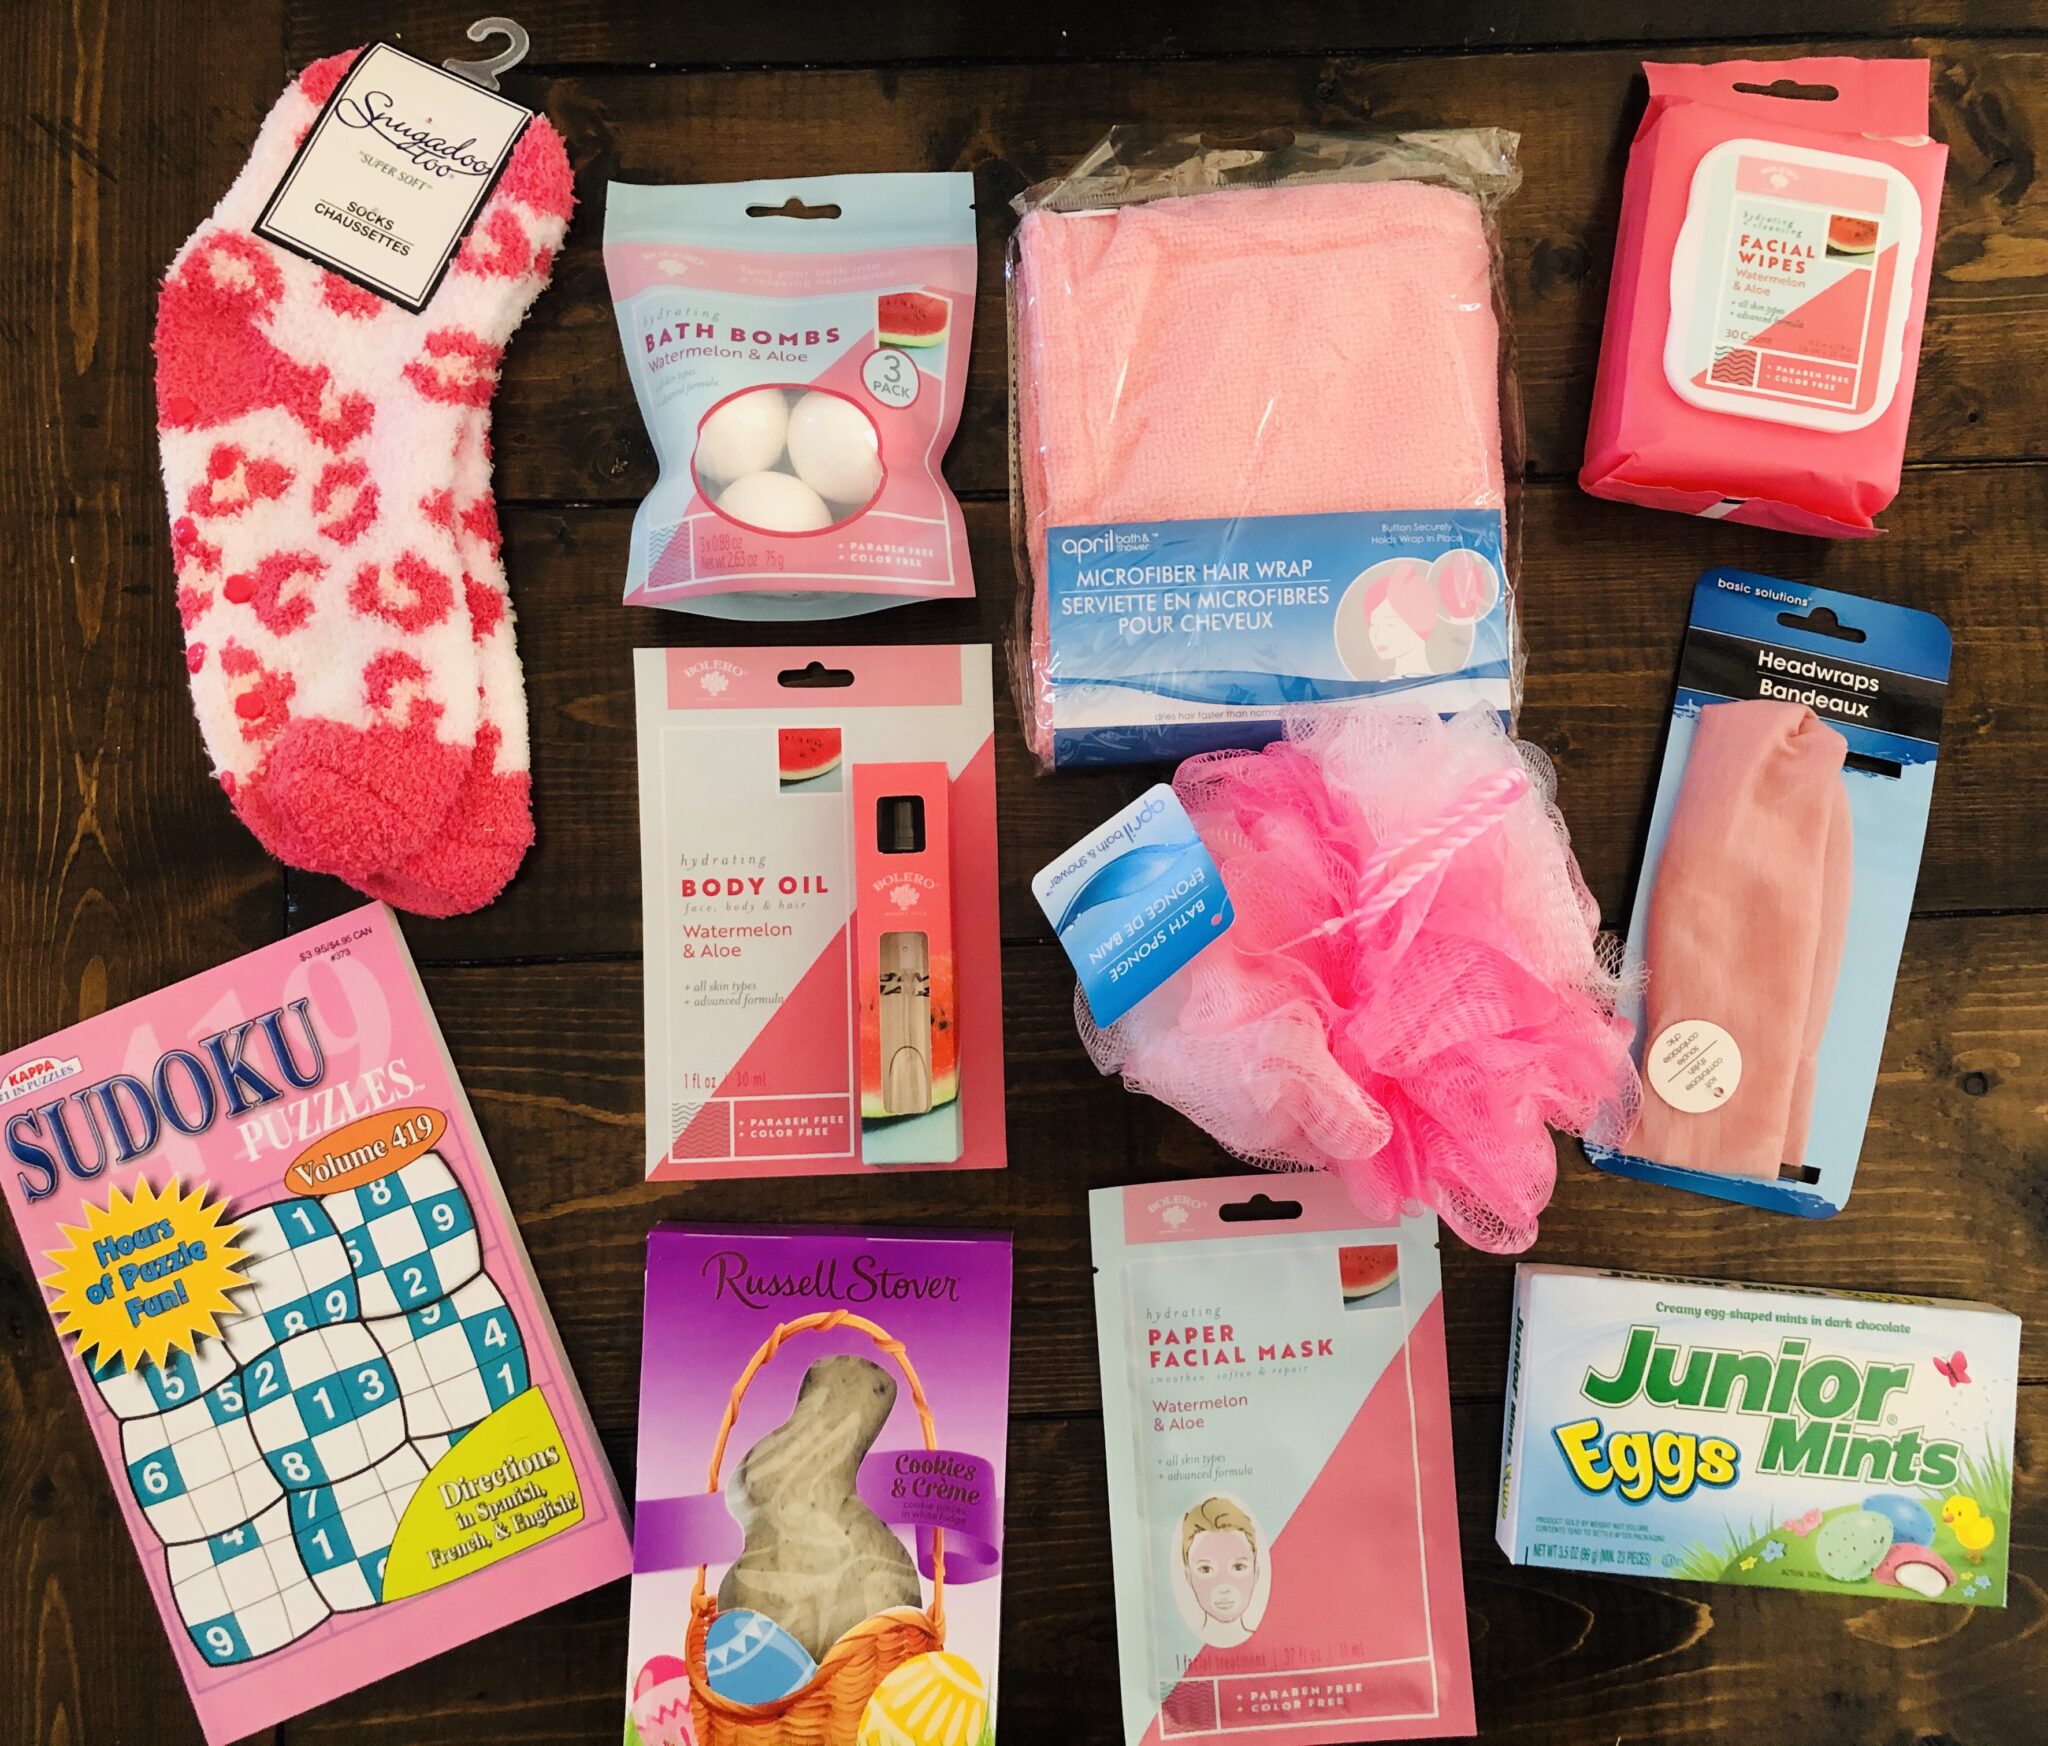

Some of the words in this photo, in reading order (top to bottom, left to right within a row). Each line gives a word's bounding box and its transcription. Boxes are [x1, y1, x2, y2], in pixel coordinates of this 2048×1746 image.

[335, 91, 493, 175] Snugadoo
[314, 202, 411, 257] CHAUSSETTES
[347, 201, 394, 231] SOCKS
[1739, 234, 1816, 259] FACIAL
[1738, 251, 1806, 274] WIPES
[1732, 281, 1742, 292] &
[1744, 284, 1771, 297] Aloe
[1735, 267, 1806, 288] Watermelon
[645, 322, 713, 353] BATH
[731, 326, 840, 346] BOMBS
[648, 345, 742, 373] Watermelon
[749, 349, 761, 360] &
[767, 350, 808, 363] Aloe
[883, 356, 901, 383] 3
[1775, 376, 1808, 387] COLOR
[1812, 381, 1835, 391] FREE
[1776, 366, 1822, 379] PARABEN
[1826, 374, 1849, 384] FREE
[873, 380, 911, 399] PACK
[1371, 535, 1397, 544] Holds
[1399, 535, 1424, 544] Wrap
[1437, 533, 1463, 542] Place
[1382, 523, 1412, 532] Button
[1413, 522, 1453, 532] Securely
[850, 542, 905, 554] PARABEN
[850, 553, 892, 564] COLOR
[1062, 529, 1114, 563] april
[1116, 543, 1150, 552] shower
[1077, 565, 1196, 587] MICROFIBER
[1203, 563, 1248, 582] HAIR
[1254, 558, 1313, 580] WRAP
[1062, 595, 1155, 615] SERVIETTE
[1164, 592, 1191, 611] EN
[1197, 586, 1330, 609] MICROFIBRES
[1718, 578, 1751, 594] basic
[1755, 586, 1808, 607] solutions
[1118, 616, 1175, 636] POUR
[1180, 611, 1273, 633] CHEVEUX
[684, 660, 744, 679] BOLERO
[1758, 650, 1880, 692] Headwraps
[1760, 678, 1869, 718] Bandeaux
[1154, 711, 1175, 721] dries
[1178, 711, 1196, 720] hair
[1198, 710, 1223, 720] faster
[1227, 709, 1248, 718] than
[1121, 797, 1167, 845] april
[1087, 848, 1097, 860] &
[1096, 831, 1125, 854] bath
[680, 853, 767, 871] hydrating
[1050, 857, 1088, 890] shower
[682, 877, 765, 898] BODY
[778, 875, 828, 895] OIL
[872, 871, 935, 892] BOLERO
[1147, 867, 1206, 921] ÉPONGE
[725, 900, 756, 914] body
[762, 900, 773, 911] &
[778, 899, 807, 911] hair
[1168, 899, 1206, 935] BATH
[353, 926, 373, 940] CAN
[683, 922, 792, 939] Watermelon
[1127, 914, 1144, 936] DE
[683, 943, 695, 958] &
[700, 943, 742, 958] Aloe
[1088, 935, 1124, 965] BAIN
[1109, 931, 1167, 983] SPONGE
[694, 980, 707, 992] all
[709, 979, 731, 992] skin
[731, 979, 757, 996] types
[694, 994, 742, 1007] advanced
[741, 993, 785, 1009] formula
[9, 1060, 54, 1086] KAPPA
[4, 997, 325, 1204] SUDOKU
[235, 1058, 417, 1162] PUZZLES
[750, 1116, 809, 1128] PARABEN
[813, 1114, 845, 1125] FREE
[750, 1128, 793, 1139] COLOR
[798, 1127, 829, 1137] FREE
[294, 1135, 388, 1188] Volume
[391, 1114, 434, 1147] 419
[291, 1207, 316, 1235] 1
[432, 1203, 455, 1231] 9
[94, 1217, 175, 1266] Hours
[85, 1277, 116, 1306] of
[121, 1238, 208, 1293] Puzzle
[403, 1267, 427, 1298] 2
[701, 1250, 846, 1310] Russell
[846, 1255, 961, 1303] Stover
[124, 1283, 189, 1329] Fun!
[1146, 1306, 1222, 1324] hydrating
[1655, 1301, 1702, 1318] Creamy
[1704, 1307, 1773, 1324] egg-shaped
[1775, 1312, 1809, 1325] mints
[1811, 1313, 1823, 1326] in
[1825, 1315, 1853, 1329] dark
[1855, 1319, 1912, 1335] chocolate
[485, 1317, 507, 1347] 4
[1148, 1324, 1235, 1346] PAPER
[1150, 1346, 1246, 1369] FACIAL
[1258, 1338, 1334, 1362] MASK
[255, 1361, 277, 1397] 2
[496, 1364, 517, 1395] 1
[1258, 1366, 1267, 1376] &
[1272, 1364, 1310, 1377] repair
[1580, 1324, 1914, 1425] Junior
[167, 1371, 185, 1400] 5
[222, 1383, 242, 1412] 5
[358, 1370, 384, 1400] 3
[313, 1391, 336, 1420] 1
[1152, 1394, 1248, 1414] Watermelon
[1154, 1418, 1165, 1432] &
[1169, 1416, 1205, 1431] Aloe
[281, 1452, 311, 1481] 8
[1166, 1454, 1179, 1467] all
[1181, 1453, 1200, 1466] skin
[1202, 1452, 1226, 1468] types
[1553, 1417, 1741, 1506] Eggs
[1756, 1416, 1963, 1489] Mints
[143, 1461, 168, 1492] 6
[437, 1444, 560, 1508] Directions
[895, 1453, 976, 1481] Cookies
[1167, 1467, 1213, 1482] advanced
[1212, 1465, 1254, 1482] formula
[891, 1477, 906, 1498] &
[912, 1476, 981, 1505] Crème
[455, 1509, 474, 1531] in
[477, 1481, 548, 1520] Spanish,
[311, 1528, 334, 1561] 1
[427, 1533, 492, 1570] French,
[494, 1519, 511, 1541] &
[512, 1492, 579, 1536] English!
[206, 1625, 234, 1657] 9
[1251, 1686, 1321, 1701] PARABEN
[1327, 1683, 1363, 1694] FREE
[1251, 1699, 1302, 1713] COLOR
[1308, 1697, 1345, 1709] FREE
